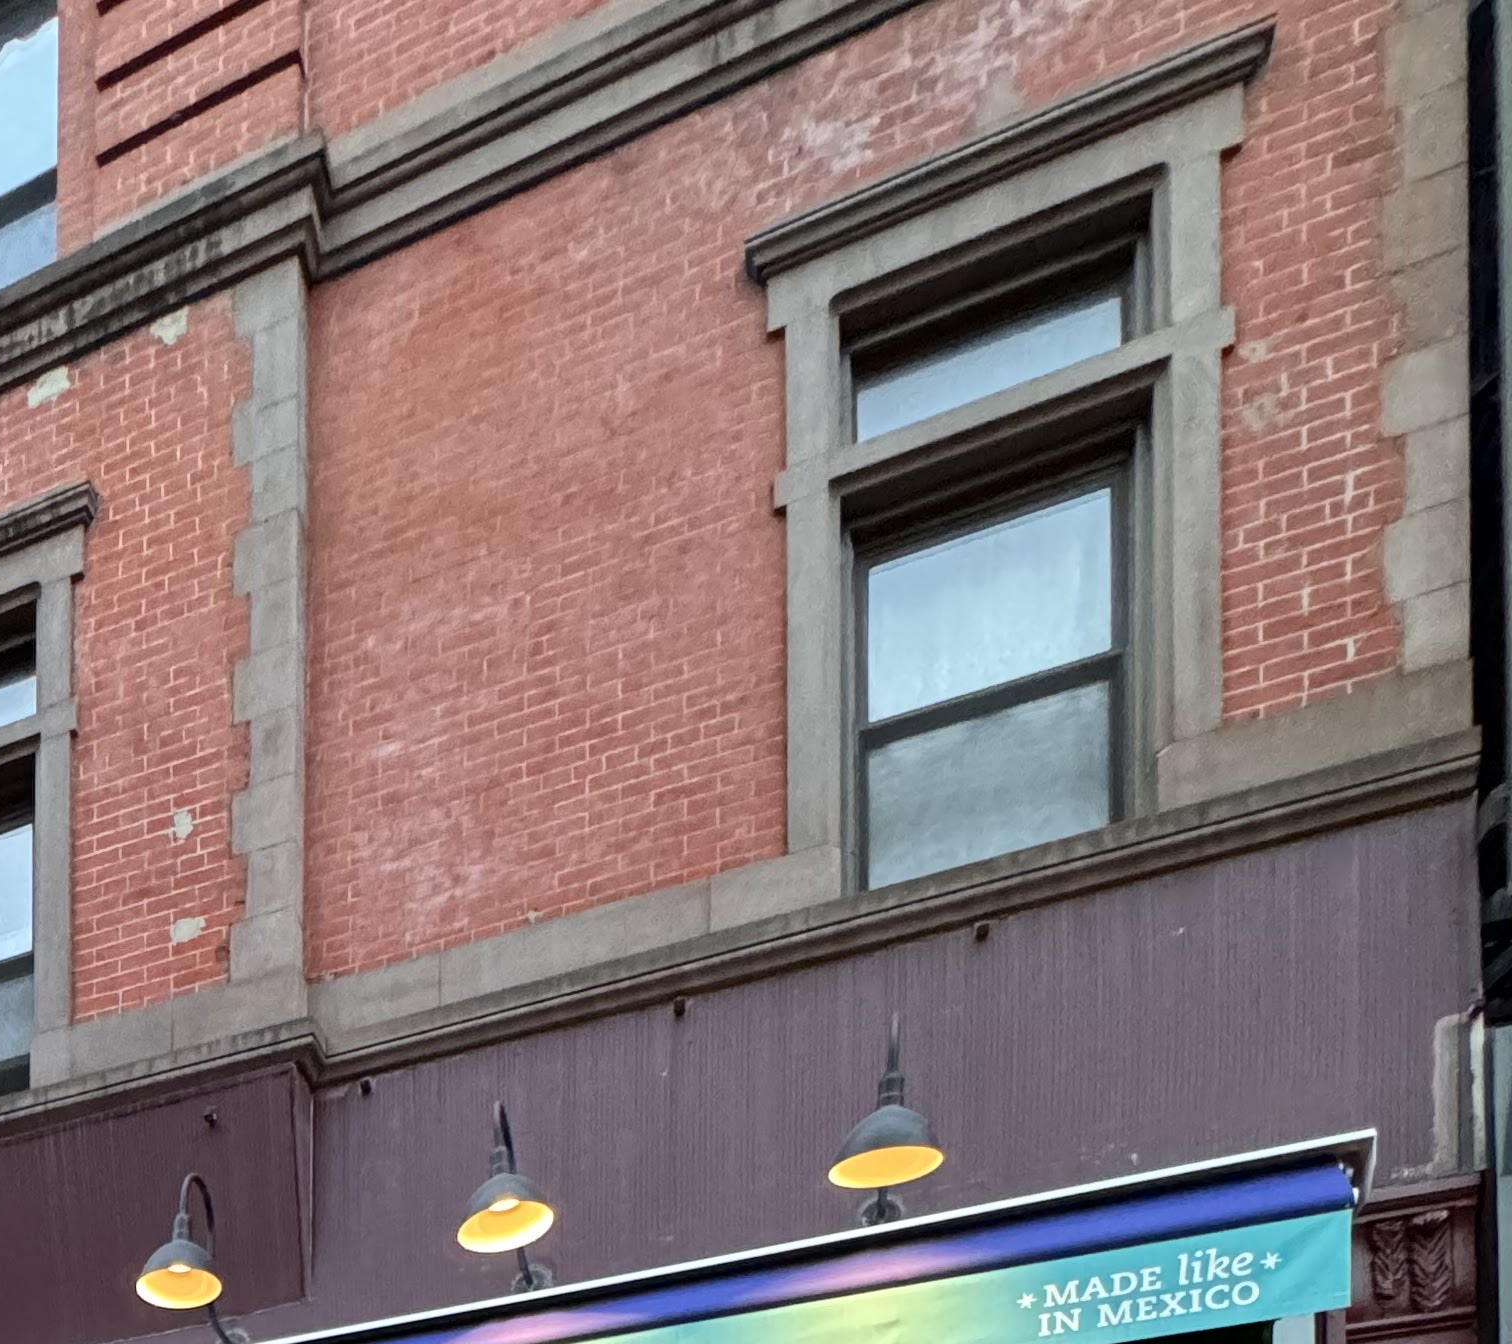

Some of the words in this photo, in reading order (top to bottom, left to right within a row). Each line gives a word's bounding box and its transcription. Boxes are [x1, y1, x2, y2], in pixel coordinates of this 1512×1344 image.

[1043, 1266, 1162, 1308] MADE
[1178, 1247, 1255, 1286] like
[1038, 1308, 1082, 1338] IN
[1096, 1280, 1261, 1328] MEXICO
